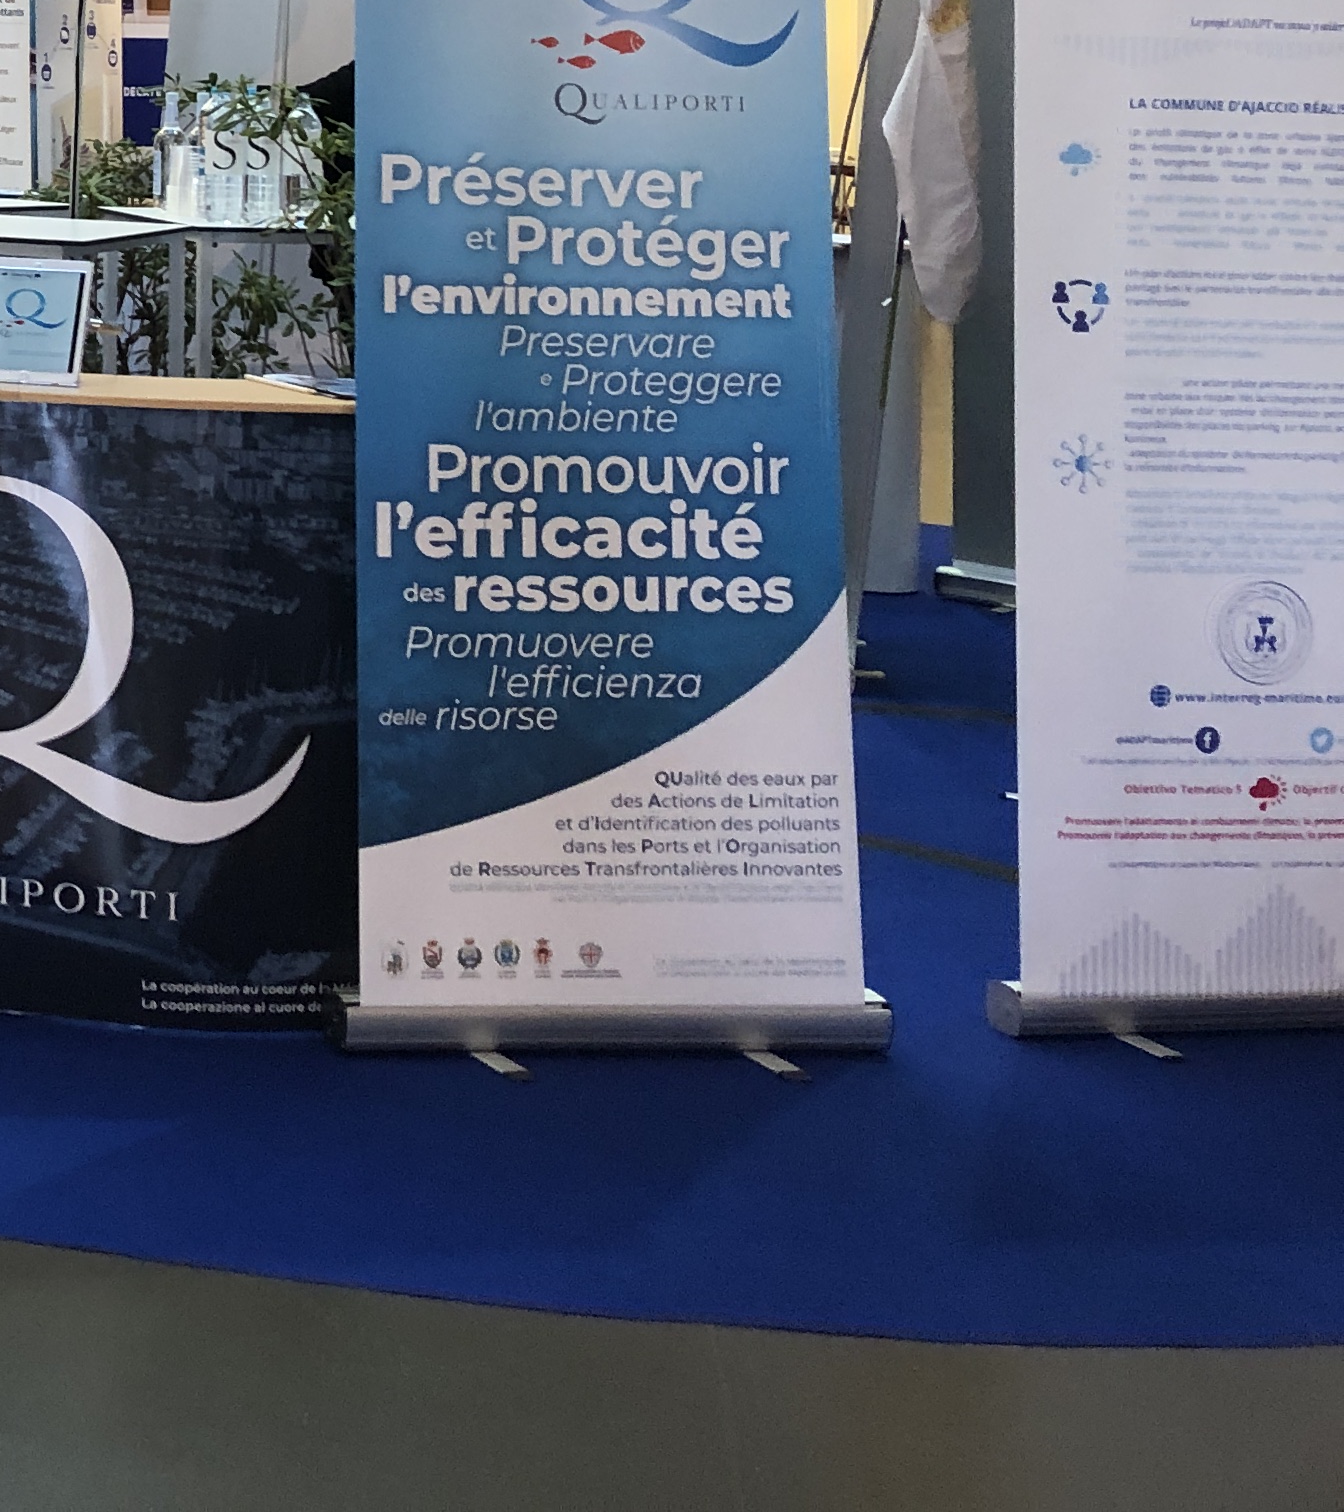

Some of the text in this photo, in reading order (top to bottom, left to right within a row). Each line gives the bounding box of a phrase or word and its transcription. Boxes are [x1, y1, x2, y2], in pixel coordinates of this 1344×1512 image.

[553, 82, 747, 125] QUALIPORTI
[1129, 98, 1299, 116] LA COMMUNE D'AJACCIO
[211, 129, 239, 172] S
[379, 151, 703, 209] Préserver
[465, 215, 790, 280] et Protéger
[5, 288, 68, 329] Q
[383, 272, 792, 319] l'environnement
[500, 325, 716, 358] Preservare
[540, 364, 783, 406] e Proteggere
[474, 400, 679, 433] l'ambiente
[427, 441, 790, 495] Promouvoir
[375, 498, 764, 561] l'efficacité
[403, 573, 794, 614] des ressources
[406, 625, 655, 659] Promuovere
[488, 666, 703, 699] l'efficienza
[378, 698, 559, 731] delle risorse
[654, 770, 839, 791] QUalité des eaux par
[611, 794, 840, 809] des Actions de Limitation
[555, 816, 841, 835] et d'Identification des polluants
[562, 838, 841, 858] dans les Ports et l'Organisation
[450, 860, 844, 877] de Ressources Transfrontalières Innovantes
[141, 979, 158, 992] La
[261, 984, 297, 996] coeur
[299, 983, 316, 995] de
[141, 997, 305, 1014] La cooperazione al cuore
